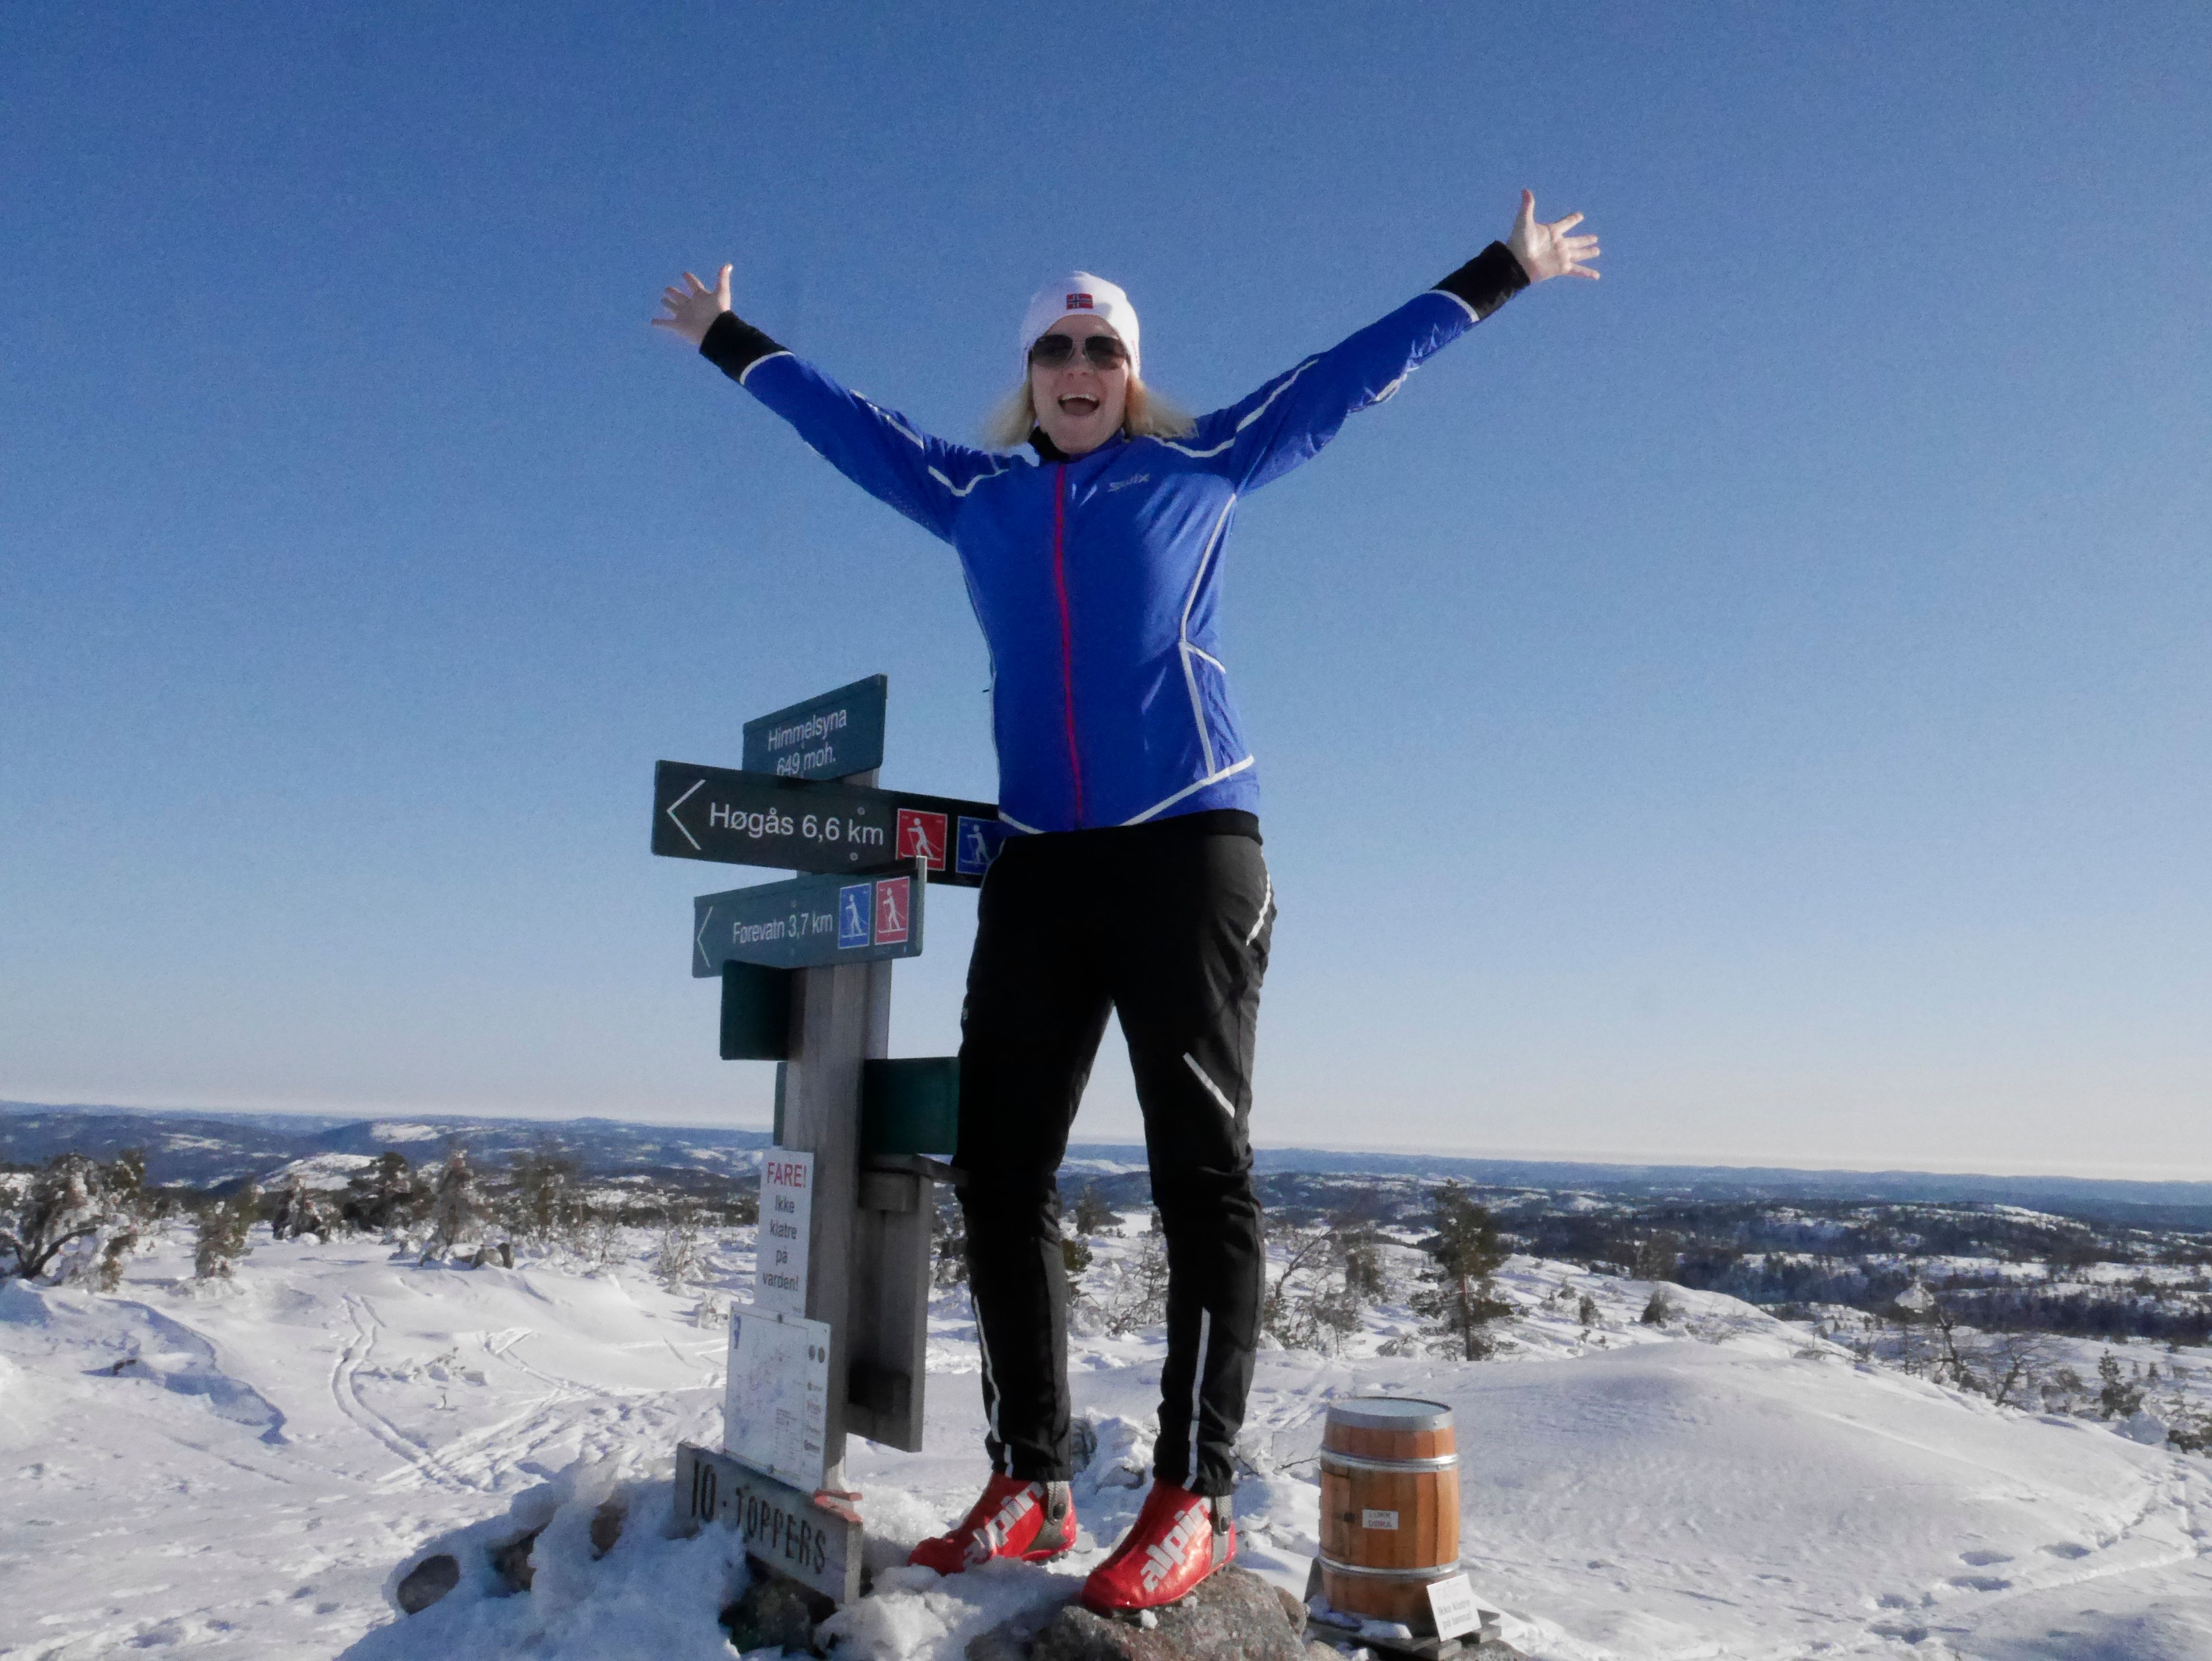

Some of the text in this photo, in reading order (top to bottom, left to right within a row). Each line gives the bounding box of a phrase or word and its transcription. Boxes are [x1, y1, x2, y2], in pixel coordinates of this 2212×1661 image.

[768, 709, 846, 752] Himmelsyna
[777, 742, 836, 776] 649 moh.
[710, 802, 883, 845] Høgås 6,6 km
[788, 913, 809, 940] 3,7
[812, 910, 833, 935] km
[767, 1161, 807, 1188] FARE!
[775, 1195, 795, 1213] Ikke
[770, 1218, 797, 1239] klatre
[776, 1245, 789, 1266] på
[763, 1272, 800, 1292] varden!
